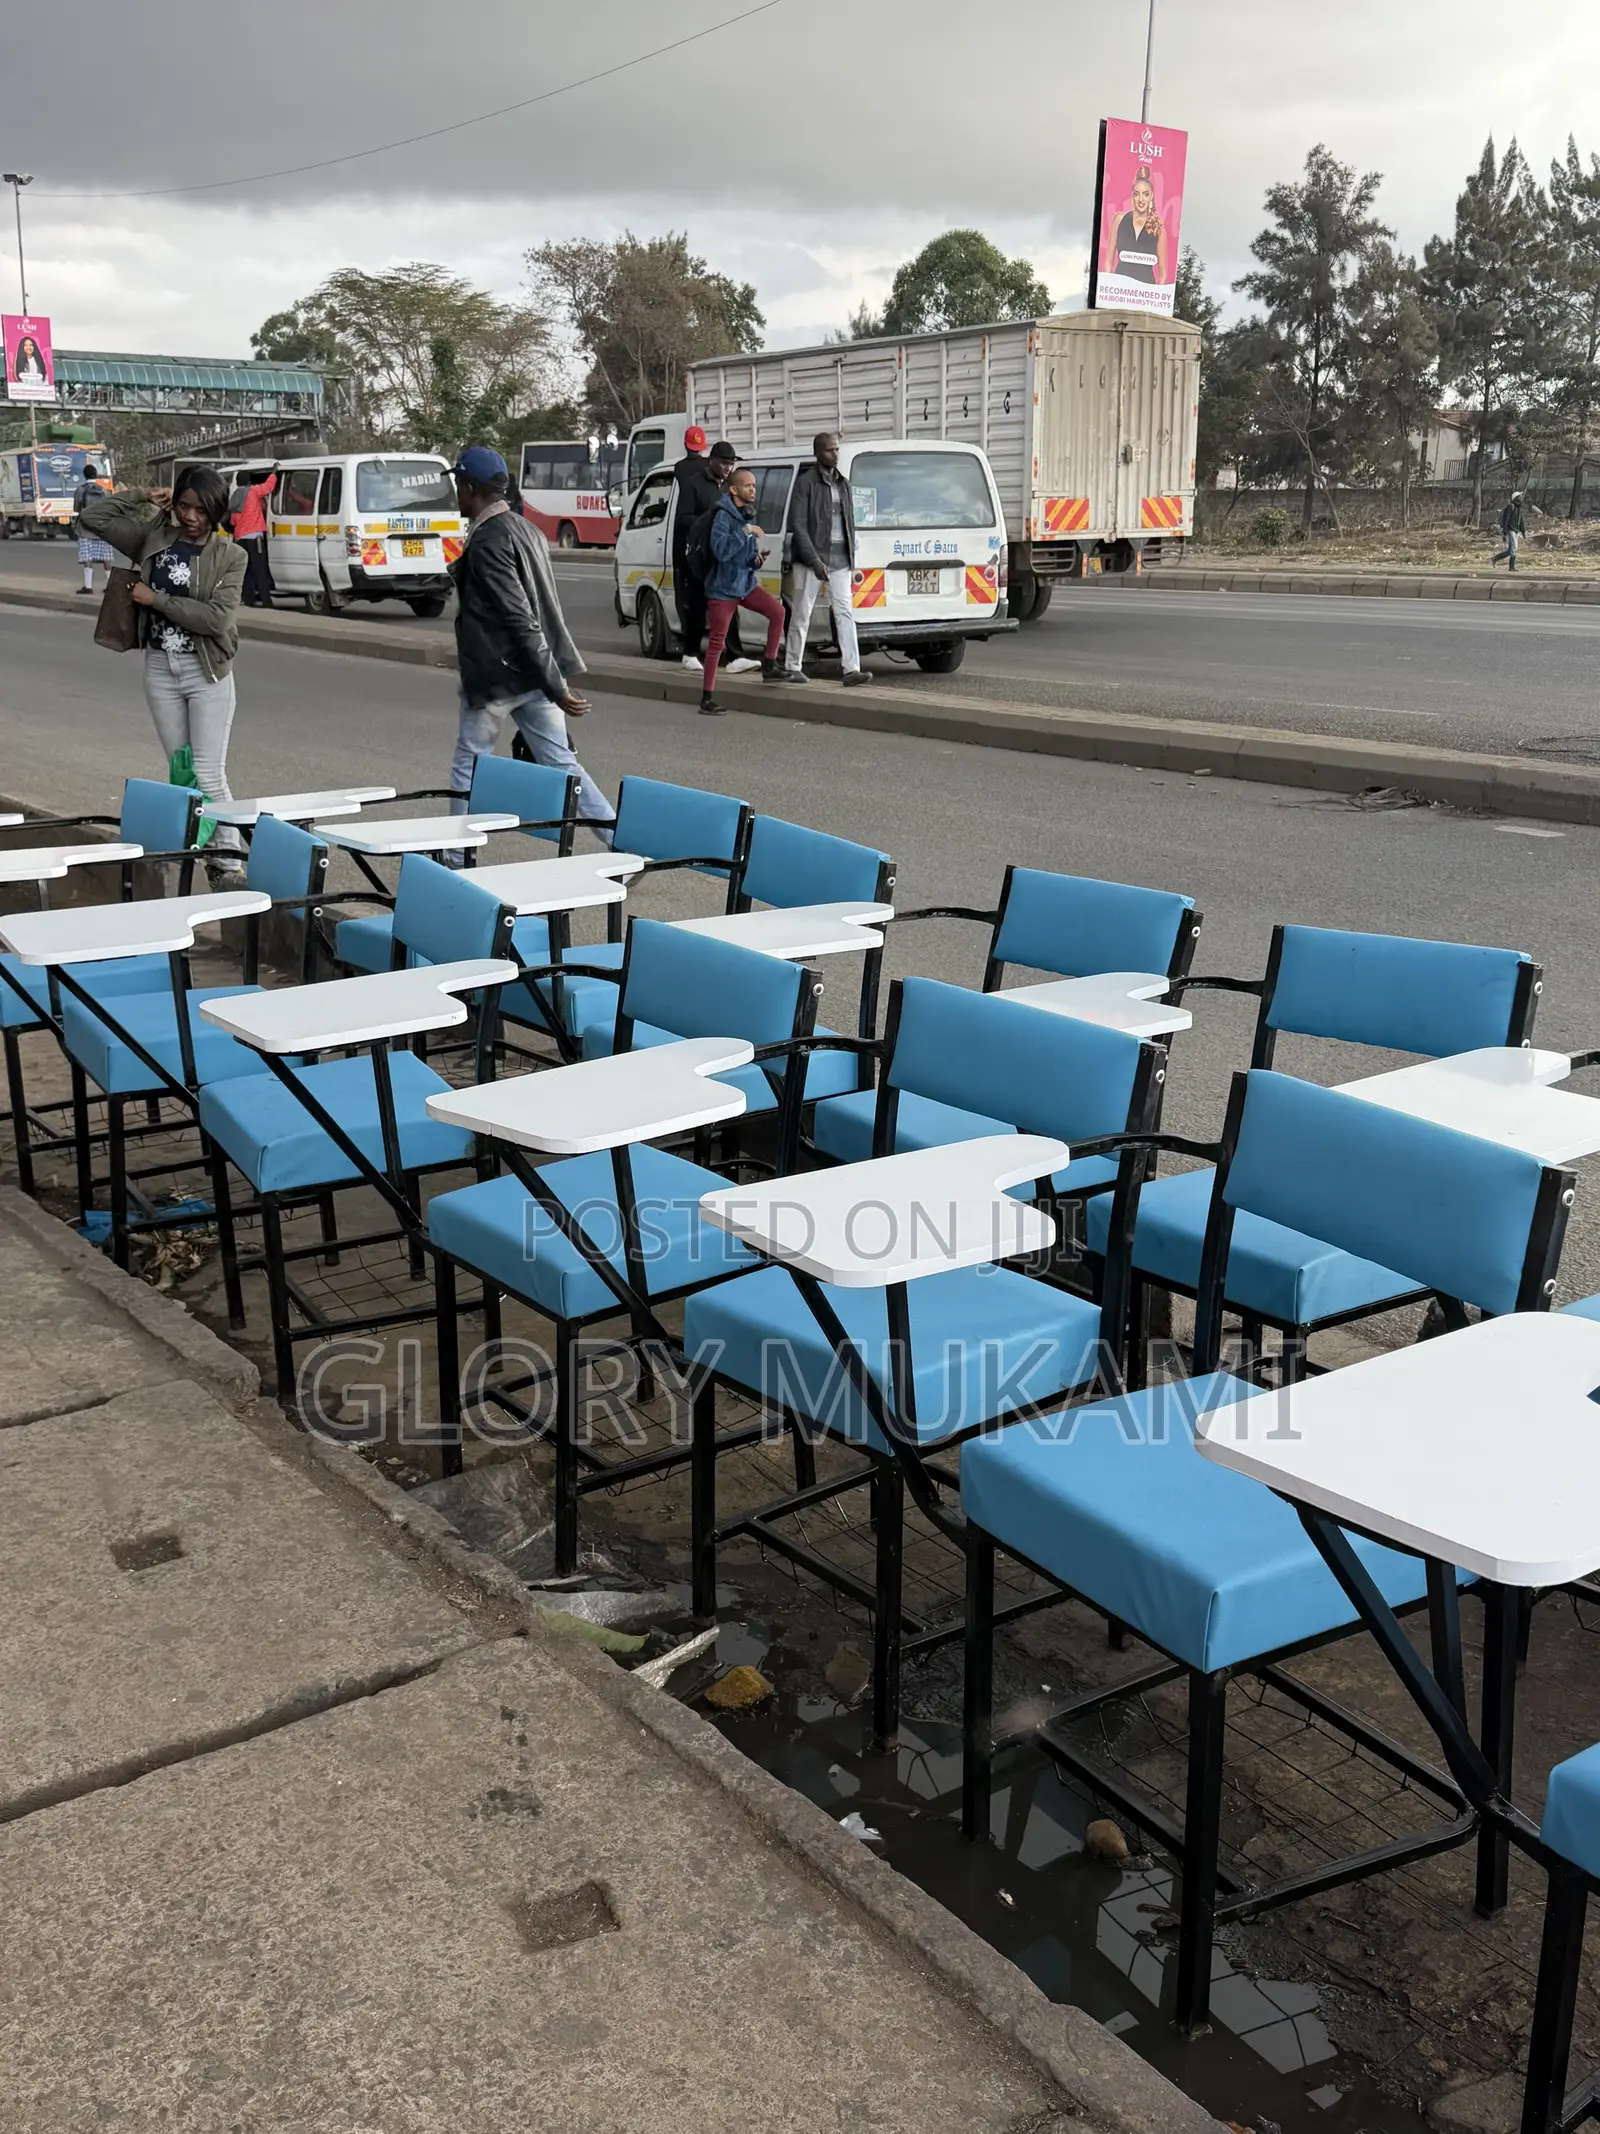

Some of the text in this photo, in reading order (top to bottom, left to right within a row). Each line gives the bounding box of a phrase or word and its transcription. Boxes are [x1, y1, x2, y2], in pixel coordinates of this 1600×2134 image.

[1129, 141, 1163, 158] LUSH
[1099, 285, 1172, 302] RECOMMENDED BY
[1126, 297, 1172, 309] HAIRSTYLISTS
[909, 568, 930, 581] KBK
[909, 582, 938, 594] 221T
